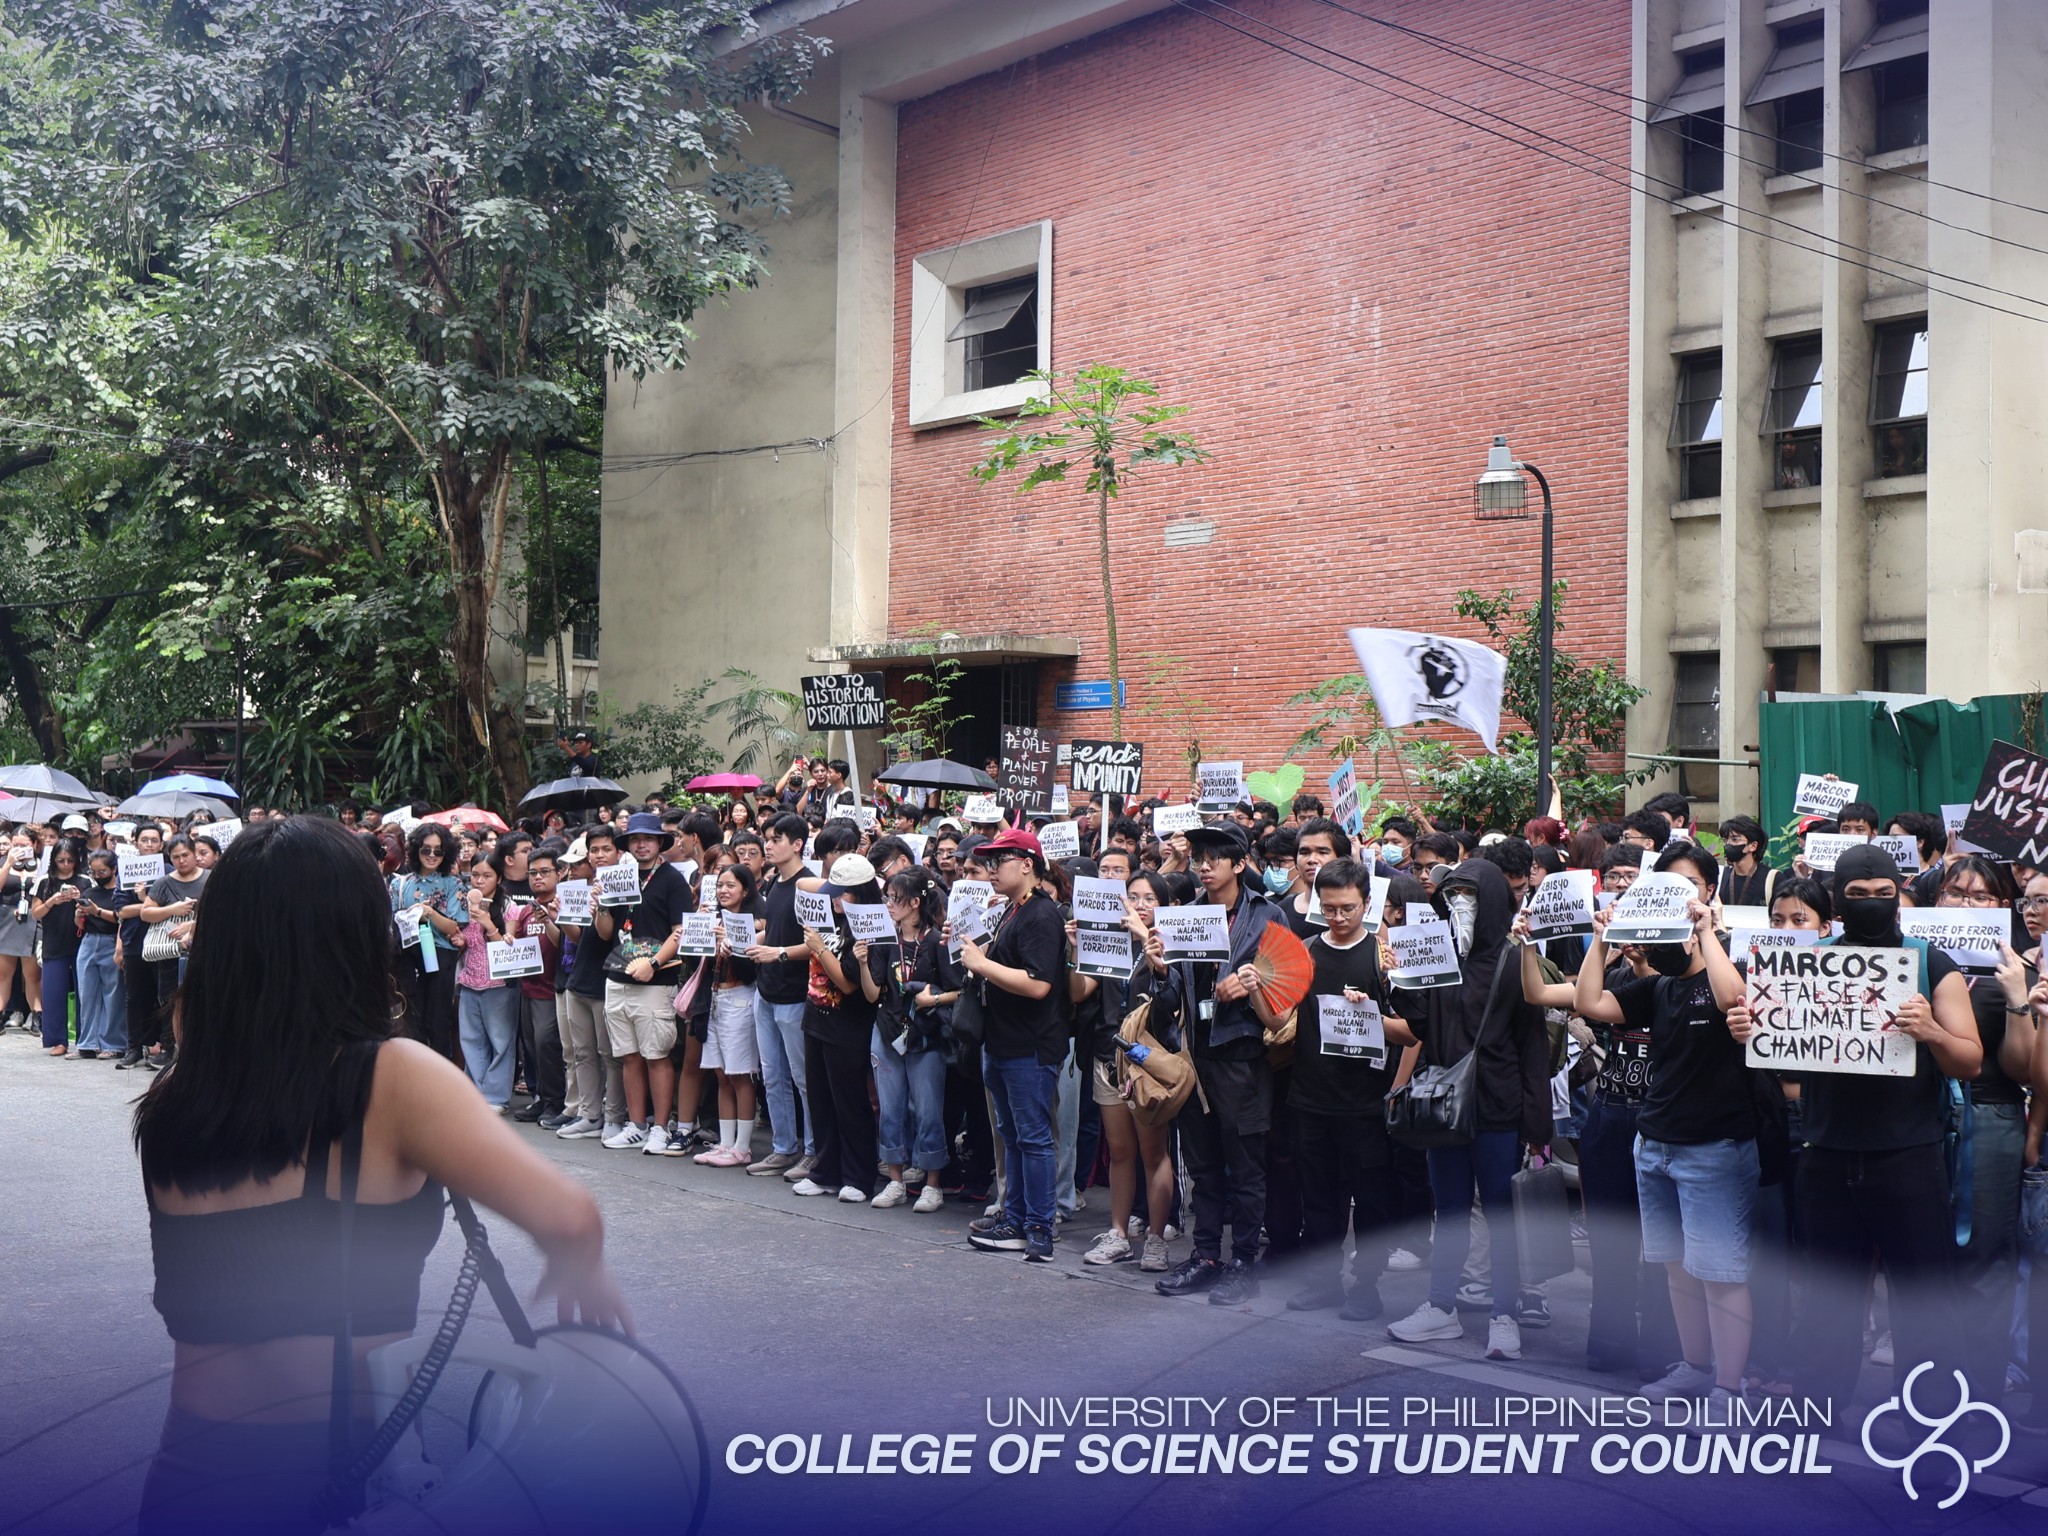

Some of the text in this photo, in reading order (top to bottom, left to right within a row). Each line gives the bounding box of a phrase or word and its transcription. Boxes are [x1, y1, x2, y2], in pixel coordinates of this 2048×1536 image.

[813, 674, 864, 689] NO TO
[805, 686, 881, 705] HISTORICAL
[807, 702, 884, 726] DISTORTION!
[1005, 731, 1051, 753] PEOPLE
[1073, 743, 1140, 764] end
[1002, 758, 1049, 774] PLANET
[1009, 774, 1038, 787] OVER
[1073, 762, 1141, 793] IMPUNITY
[1203, 778, 1236, 788] BURUKRATA
[1337, 771, 1351, 797] JUST
[1804, 781, 1851, 797] MARCOS
[999, 788, 1048, 808] PROFIT
[1203, 788, 1239, 798] KAPITALISMO
[1802, 792, 1849, 809] SINGILIN
[841, 809, 872, 819] MAROS
[1880, 841, 1904, 851] STOP
[125, 861, 158, 870] KURAKOT
[124, 869, 160, 877] MANAGOT!
[600, 869, 634, 882] MARCOS
[603, 881, 635, 893] SINGILIN
[1539, 879, 1569, 892] RBISYO
[1663, 886, 1692, 897] PESTE
[1077, 890, 1094, 899] SOURCE
[1536, 893, 1545, 904] SA
[1078, 899, 1122, 911] MARCOS JR.
[1637, 898, 1670, 908] SA MGA
[1525, 905, 1550, 918] UWAG
[1620, 907, 1684, 918] LABORATORYO!
[1159, 918, 1185, 926] MARCOS
[1193, 917, 1223, 926] DUTERTE
[1539, 912, 1575, 924] NEGOSYO
[1177, 926, 1205, 934] WALANG
[1910, 925, 2003, 936] SOURCE OF ERROR:
[1391, 939, 1417, 949] MARCOS
[1425, 935, 1445, 946] PESTE
[1750, 935, 1796, 946] SERBISYO
[492, 948, 520, 957] TUTULAN
[1083, 942, 1128, 956] CORRUPTION
[1408, 947, 1433, 958] SA MGA
[494, 952, 537, 964] BUDGET CUT!
[1400, 954, 1447, 968] LABORATORYO!
[1780, 980, 1860, 1005] FALSE
[1323, 1008, 1345, 1017] MARCOS
[1353, 1010, 1378, 1020] DUTERTE
[1768, 1007, 1877, 1031] CLIMATE
[1338, 1018, 1364, 1027] WALANG
[1752, 1033, 1885, 1064] CHAMPION
